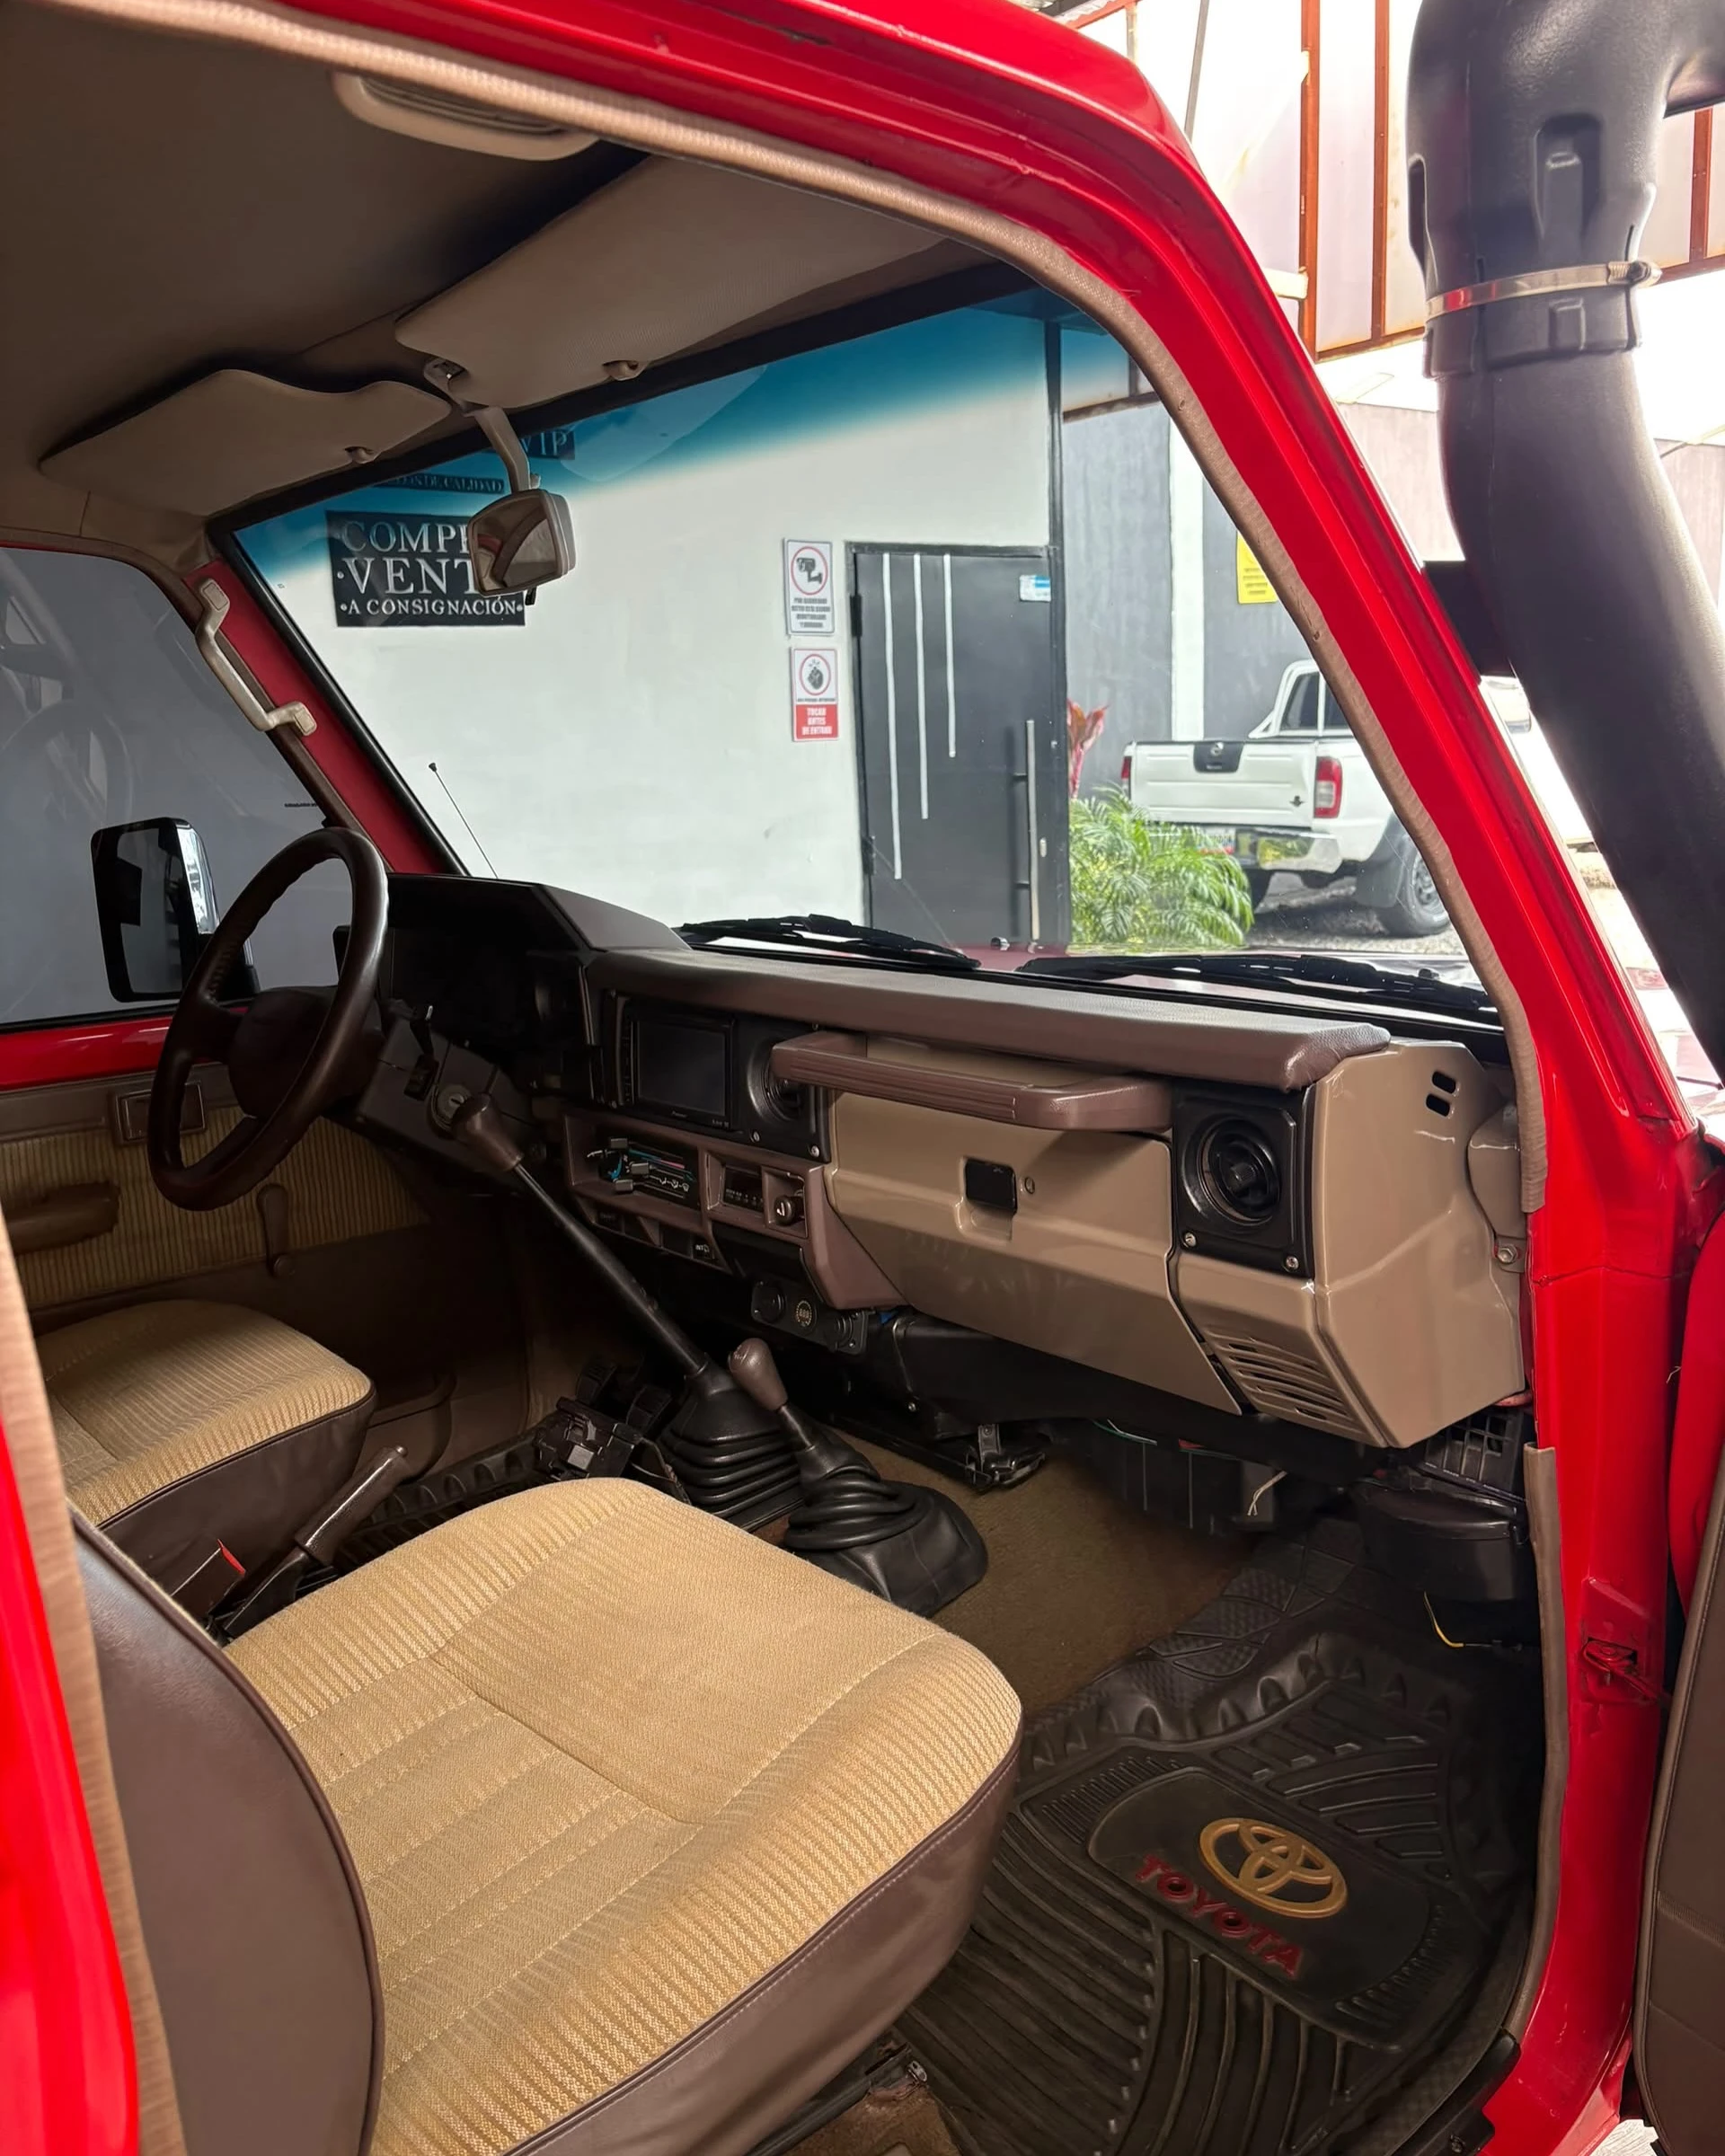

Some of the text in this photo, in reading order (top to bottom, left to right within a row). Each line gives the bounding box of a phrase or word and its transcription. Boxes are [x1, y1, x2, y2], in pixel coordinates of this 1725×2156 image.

[343, 521, 470, 553] COMP
[342, 557, 479, 594] VENT
[367, 596, 517, 615] CONSIGNACIÓN
[1137, 1855, 1302, 1977] TOYOTA
